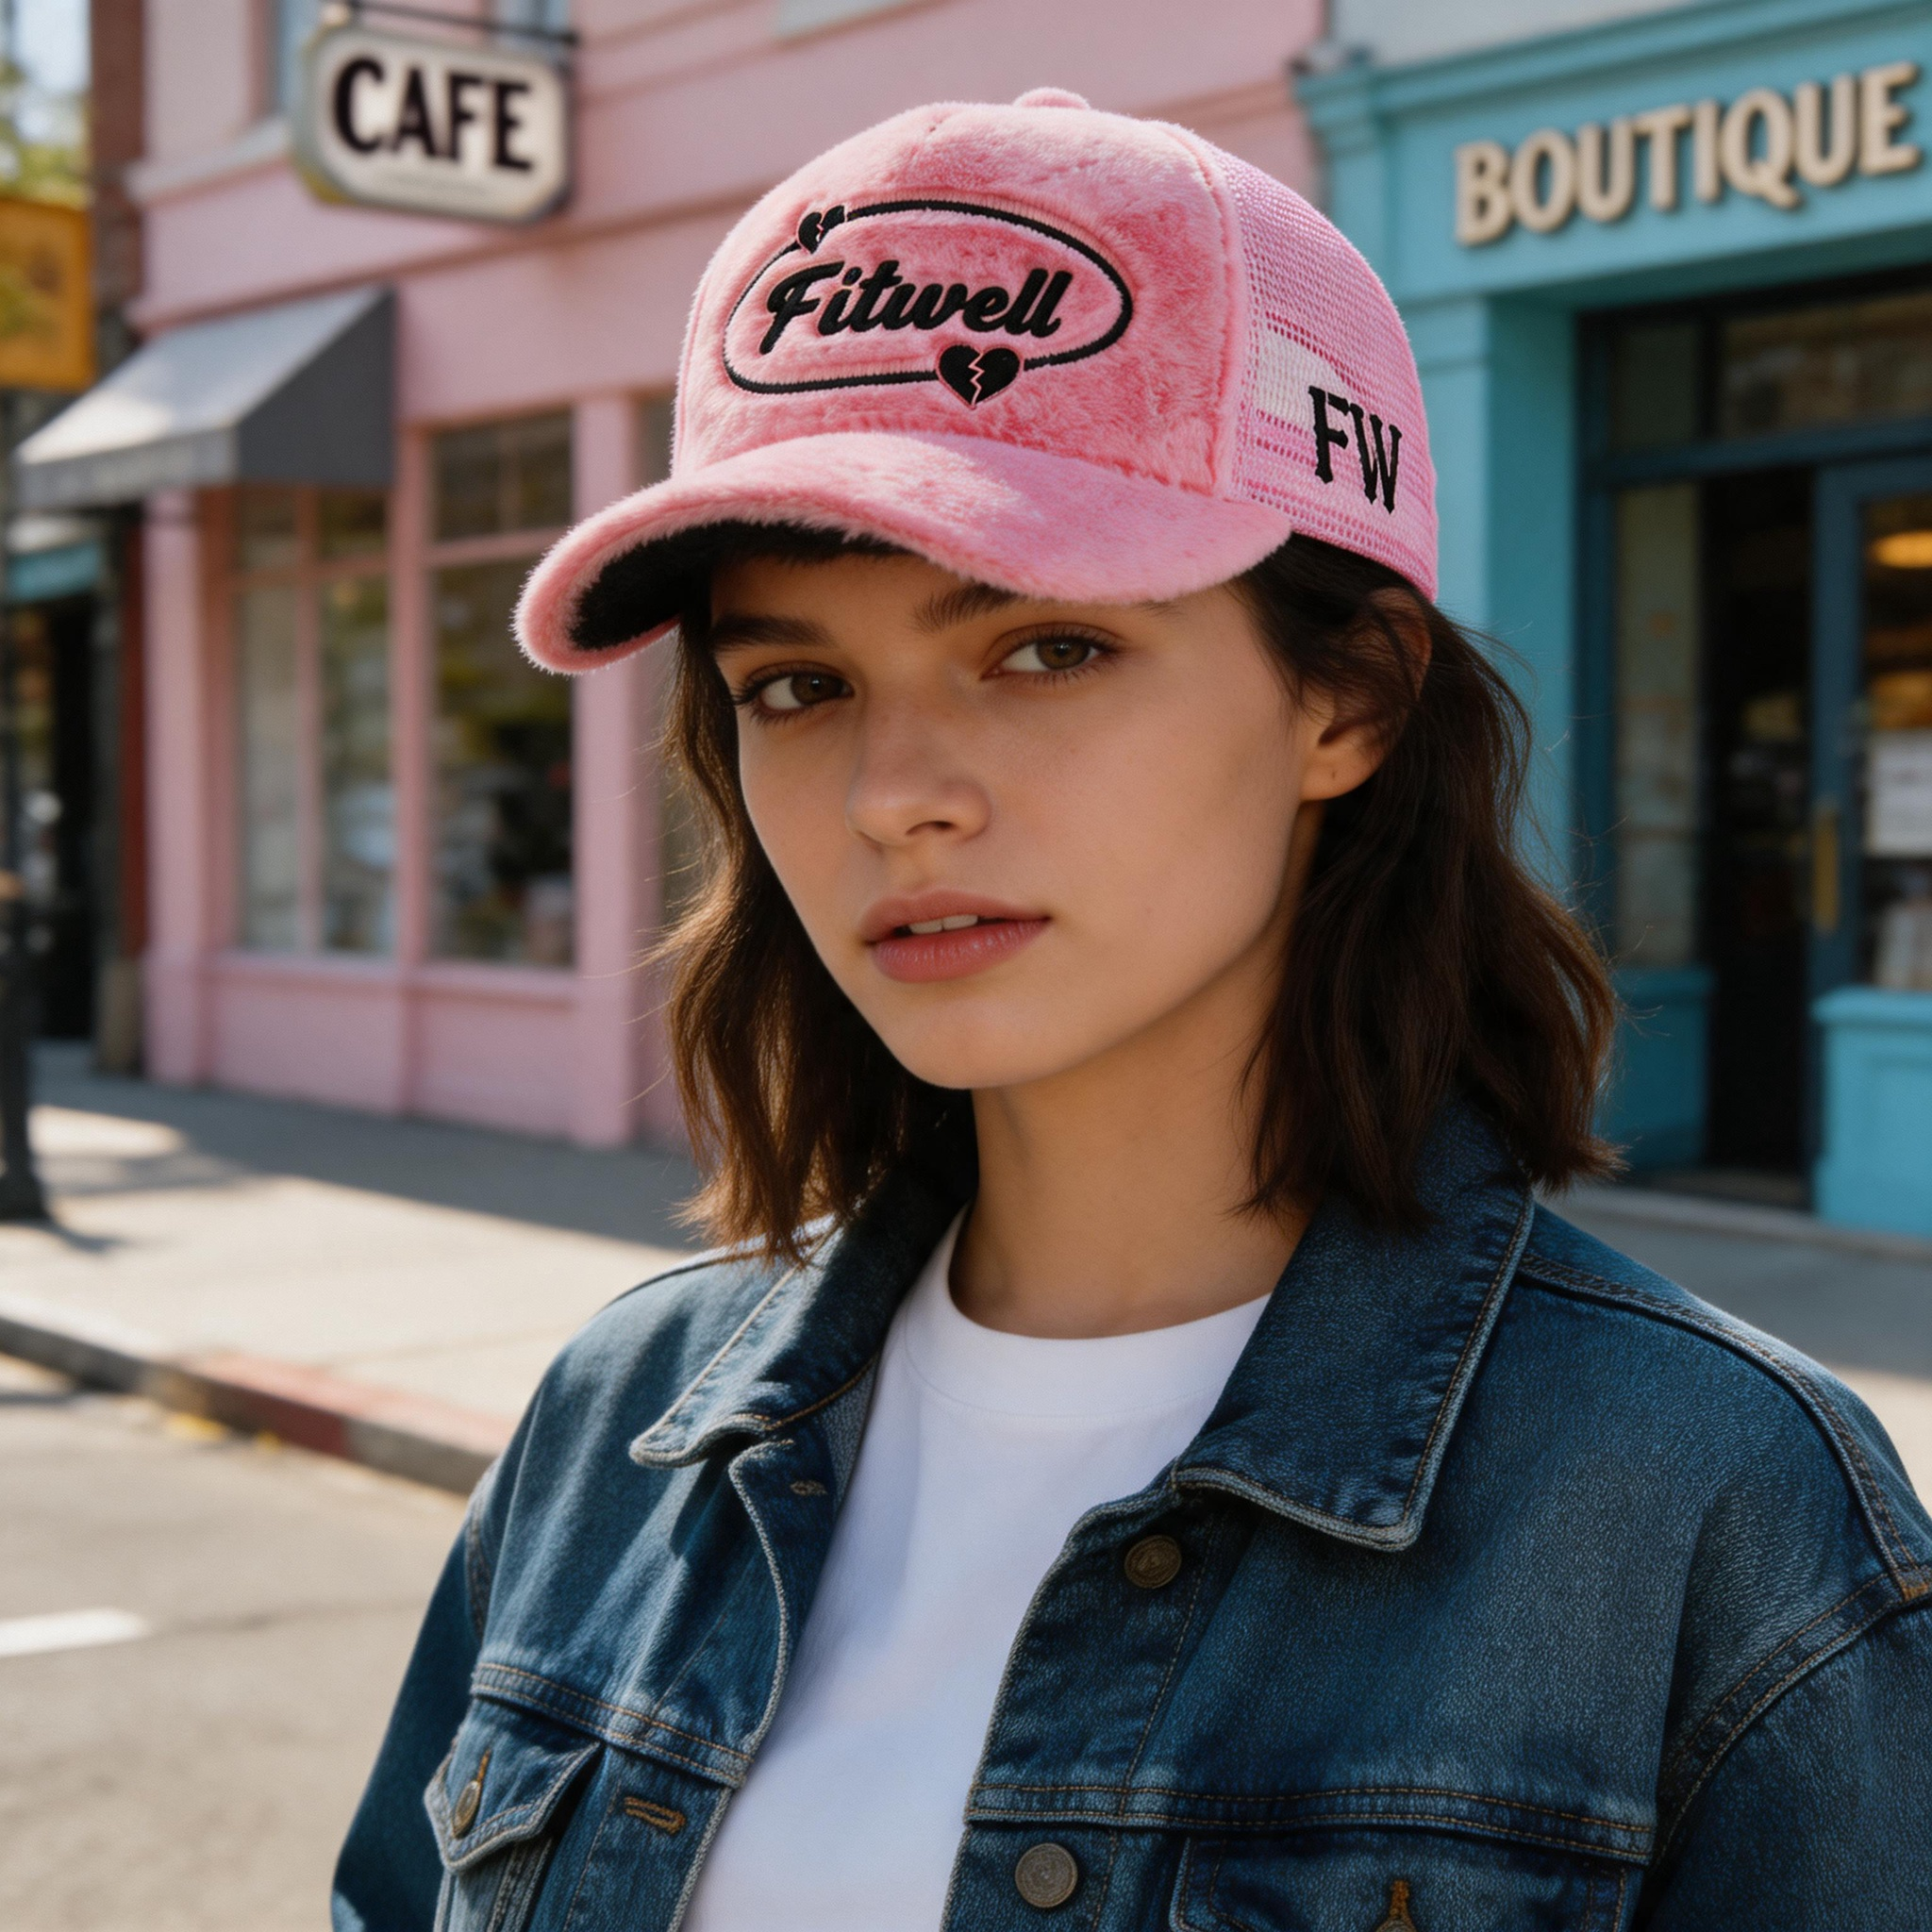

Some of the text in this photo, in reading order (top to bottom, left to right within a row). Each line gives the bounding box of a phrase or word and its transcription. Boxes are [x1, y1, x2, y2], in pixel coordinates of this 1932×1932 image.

[334, 57, 534, 173] CAFE
[1456, 62, 1921, 246] BOUTIQUE
[758, 259, 1074, 355] Fitwell
[1308, 385, 1402, 514] FW
